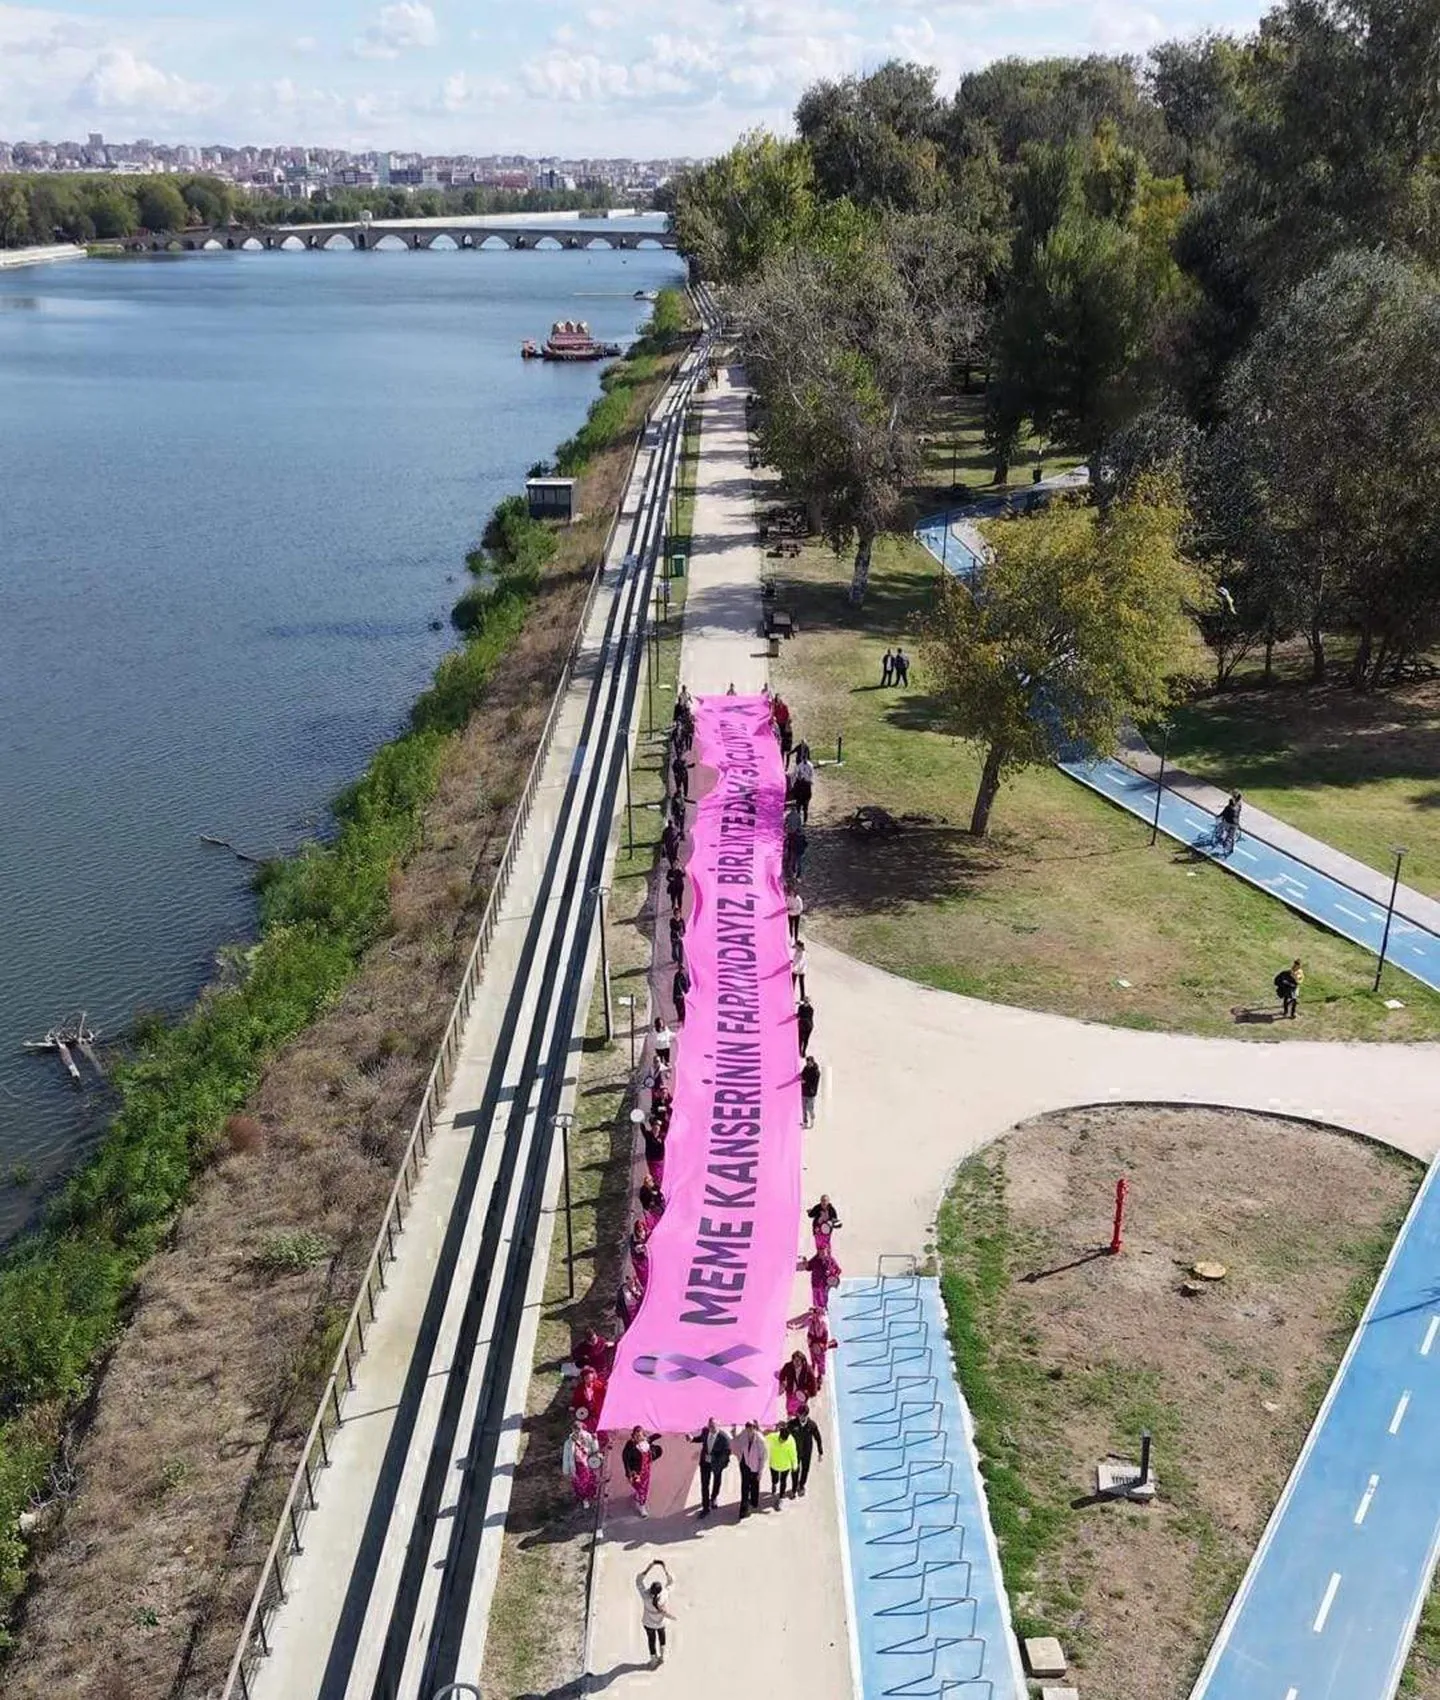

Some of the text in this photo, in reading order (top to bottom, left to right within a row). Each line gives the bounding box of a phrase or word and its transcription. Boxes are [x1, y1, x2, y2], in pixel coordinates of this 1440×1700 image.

[708, 817, 755, 885] BİRLİKTE
[717, 893, 761, 1034] FARKINDAYIZ,
[701, 1040, 761, 1208] KANSERİNİN
[679, 1217, 753, 1325] MEME
